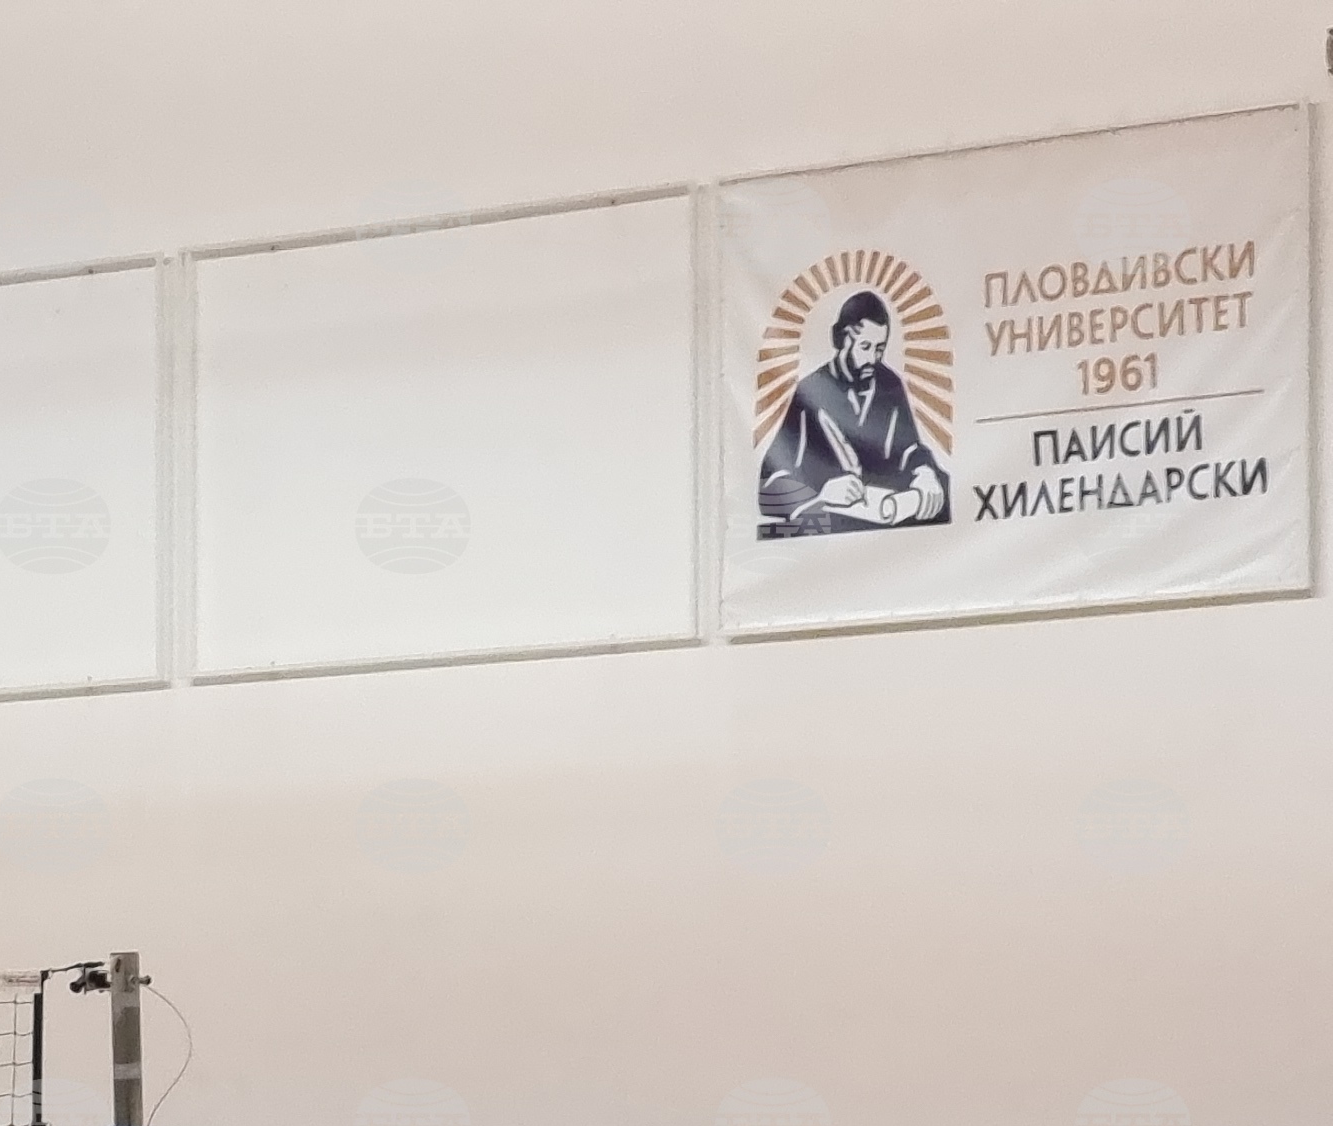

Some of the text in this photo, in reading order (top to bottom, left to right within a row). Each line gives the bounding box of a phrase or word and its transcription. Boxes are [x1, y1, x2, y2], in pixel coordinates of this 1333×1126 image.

[985, 241, 1256, 307] ПЛОВДИВСКИ
[984, 291, 1255, 356] УНИВЕРСИТЕТ
[1077, 352, 1159, 395] 1961
[1033, 409, 1204, 466] ПАИСИЙ
[973, 457, 1270, 522] ХИЛЕНДАРСКИ
